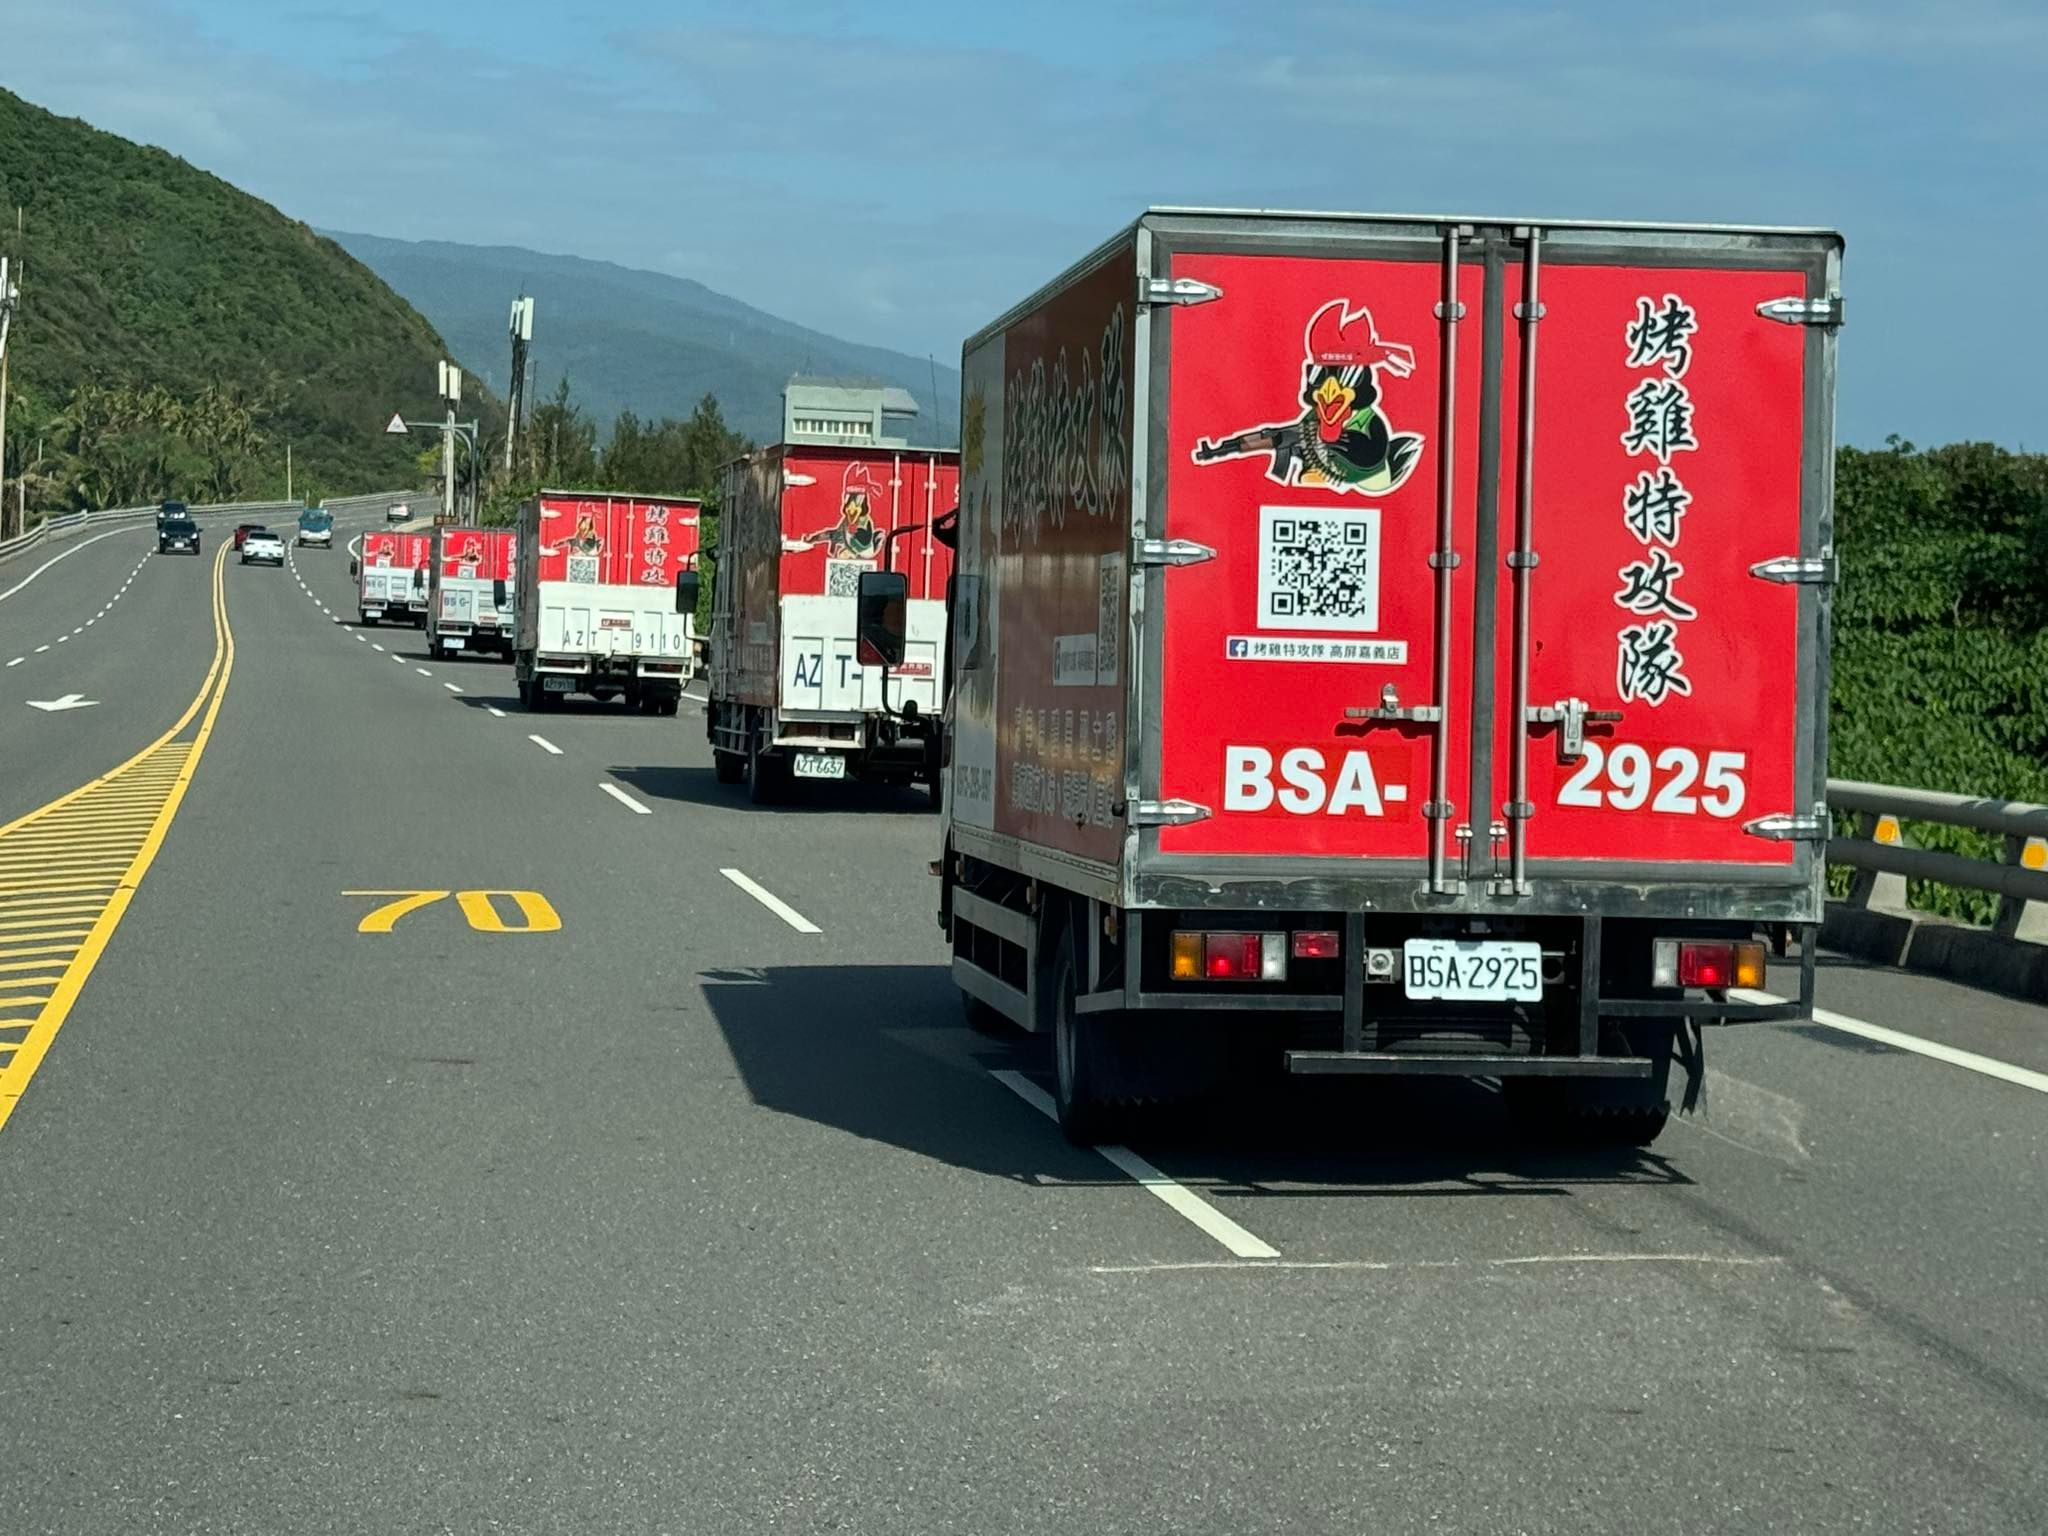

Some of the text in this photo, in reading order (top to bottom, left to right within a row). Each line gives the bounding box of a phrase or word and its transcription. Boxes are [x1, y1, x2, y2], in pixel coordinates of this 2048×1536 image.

[1616, 296, 1697, 705] 烤雞特攻隊
[1253, 642, 1324, 658] 烤雞特攻隊
[1329, 644, 1400, 660] 高屏嘉義店
[1225, 744, 1746, 818] BSA- 2925
[341, 890, 562, 933] 70
